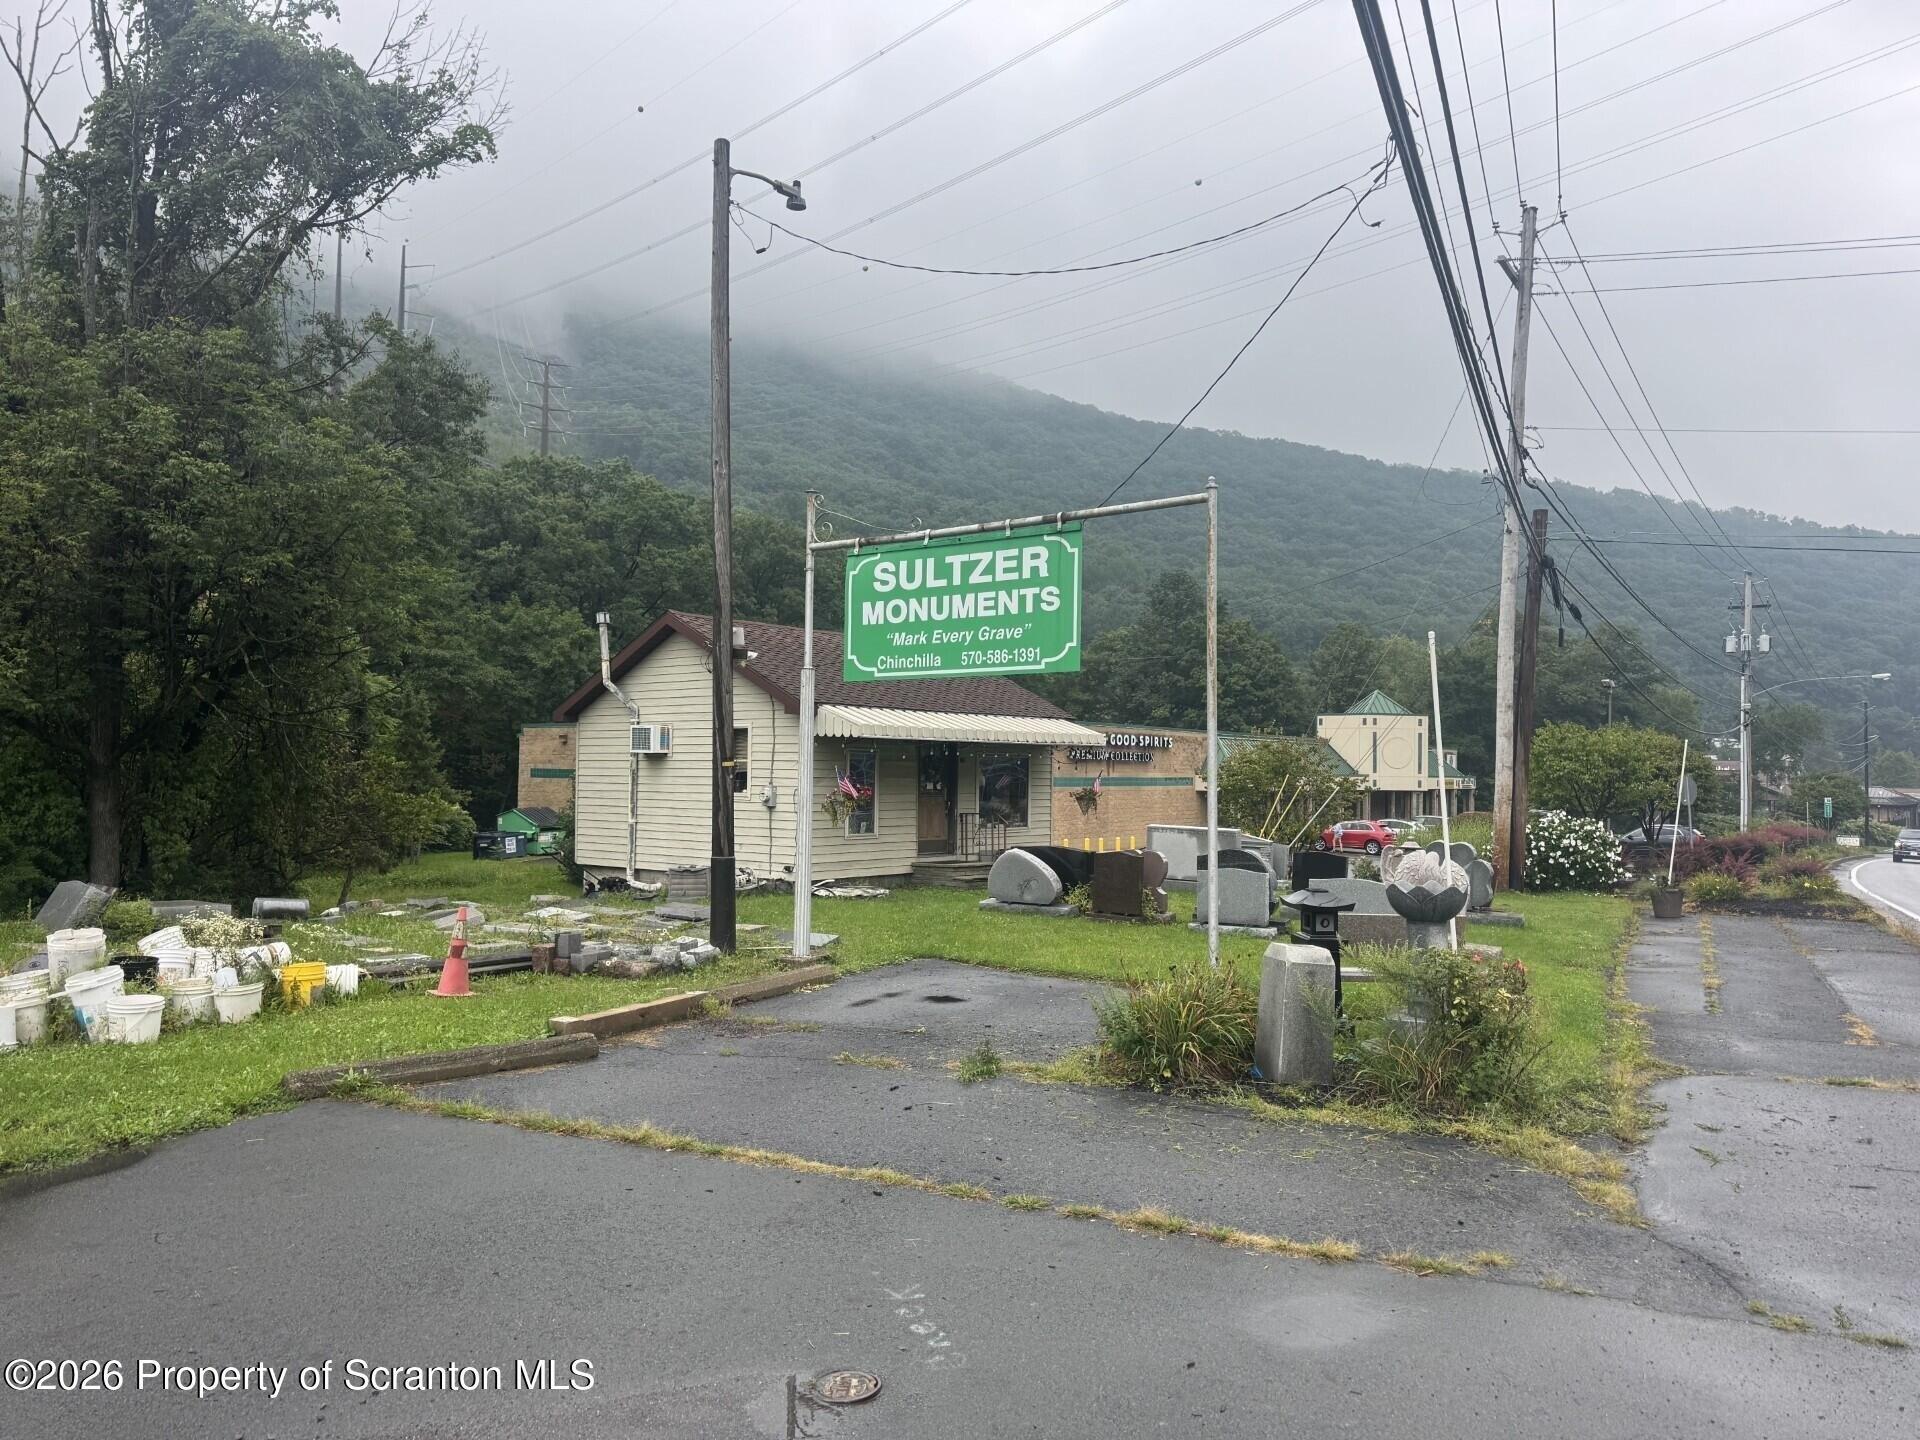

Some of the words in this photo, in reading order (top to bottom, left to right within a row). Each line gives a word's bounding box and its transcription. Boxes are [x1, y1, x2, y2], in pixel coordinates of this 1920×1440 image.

[873, 546, 1049, 592] SULTZER
[862, 585, 1061, 625] MONUMENTS
[932, 627, 973, 645] Every
[877, 653, 941, 670] Chinchilla
[961, 647, 1041, 666] 570-586-1391
[1110, 734, 1137, 746] GOOD
[1139, 735, 1173, 748] SPIRITS
[1110, 751, 1154, 762] COLLECTION
